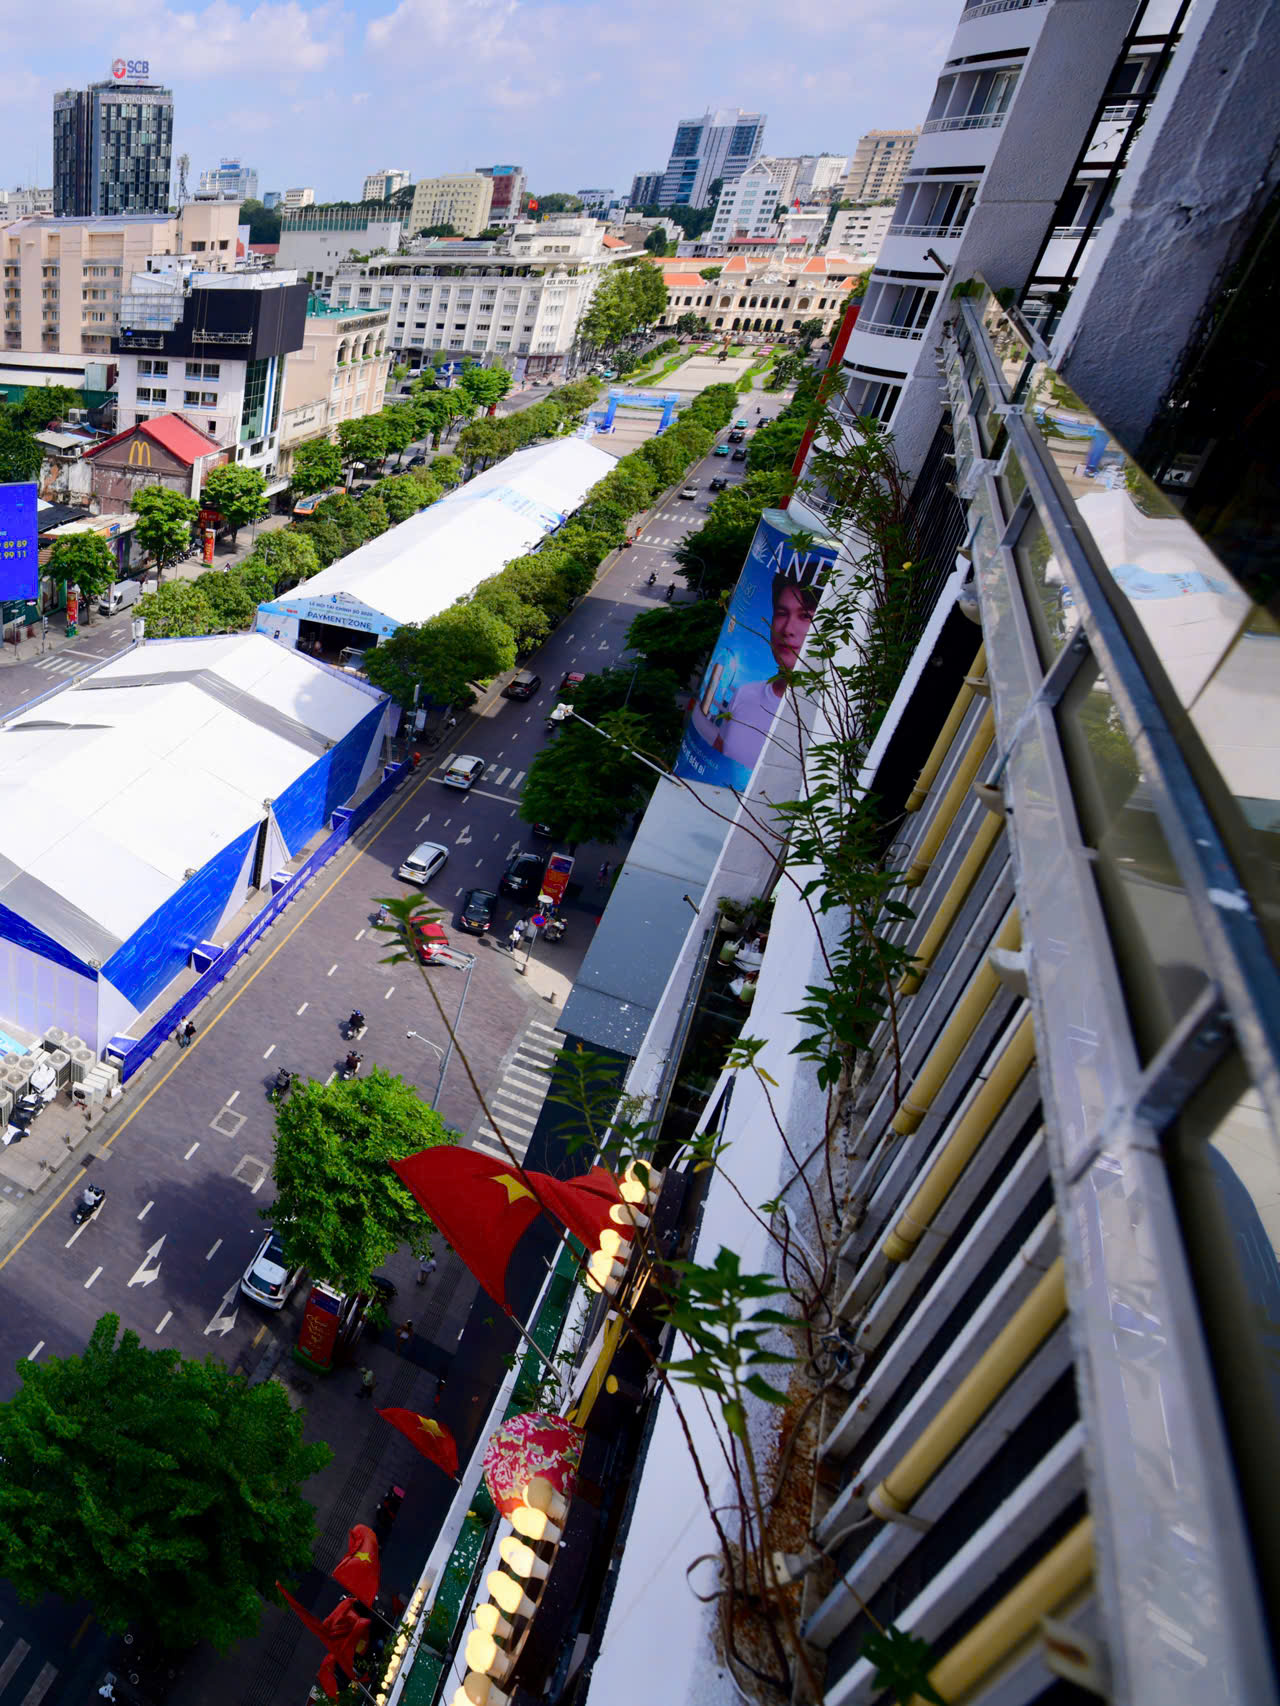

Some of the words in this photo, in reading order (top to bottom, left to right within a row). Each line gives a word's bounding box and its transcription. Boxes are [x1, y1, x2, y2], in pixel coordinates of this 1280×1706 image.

[127, 60, 149, 74] SCB
[4, 551, 15, 559] 99
[17, 550, 27, 558] 11
[307, 611, 346, 626] PAYMENT
[348, 618, 372, 631] ZONE
